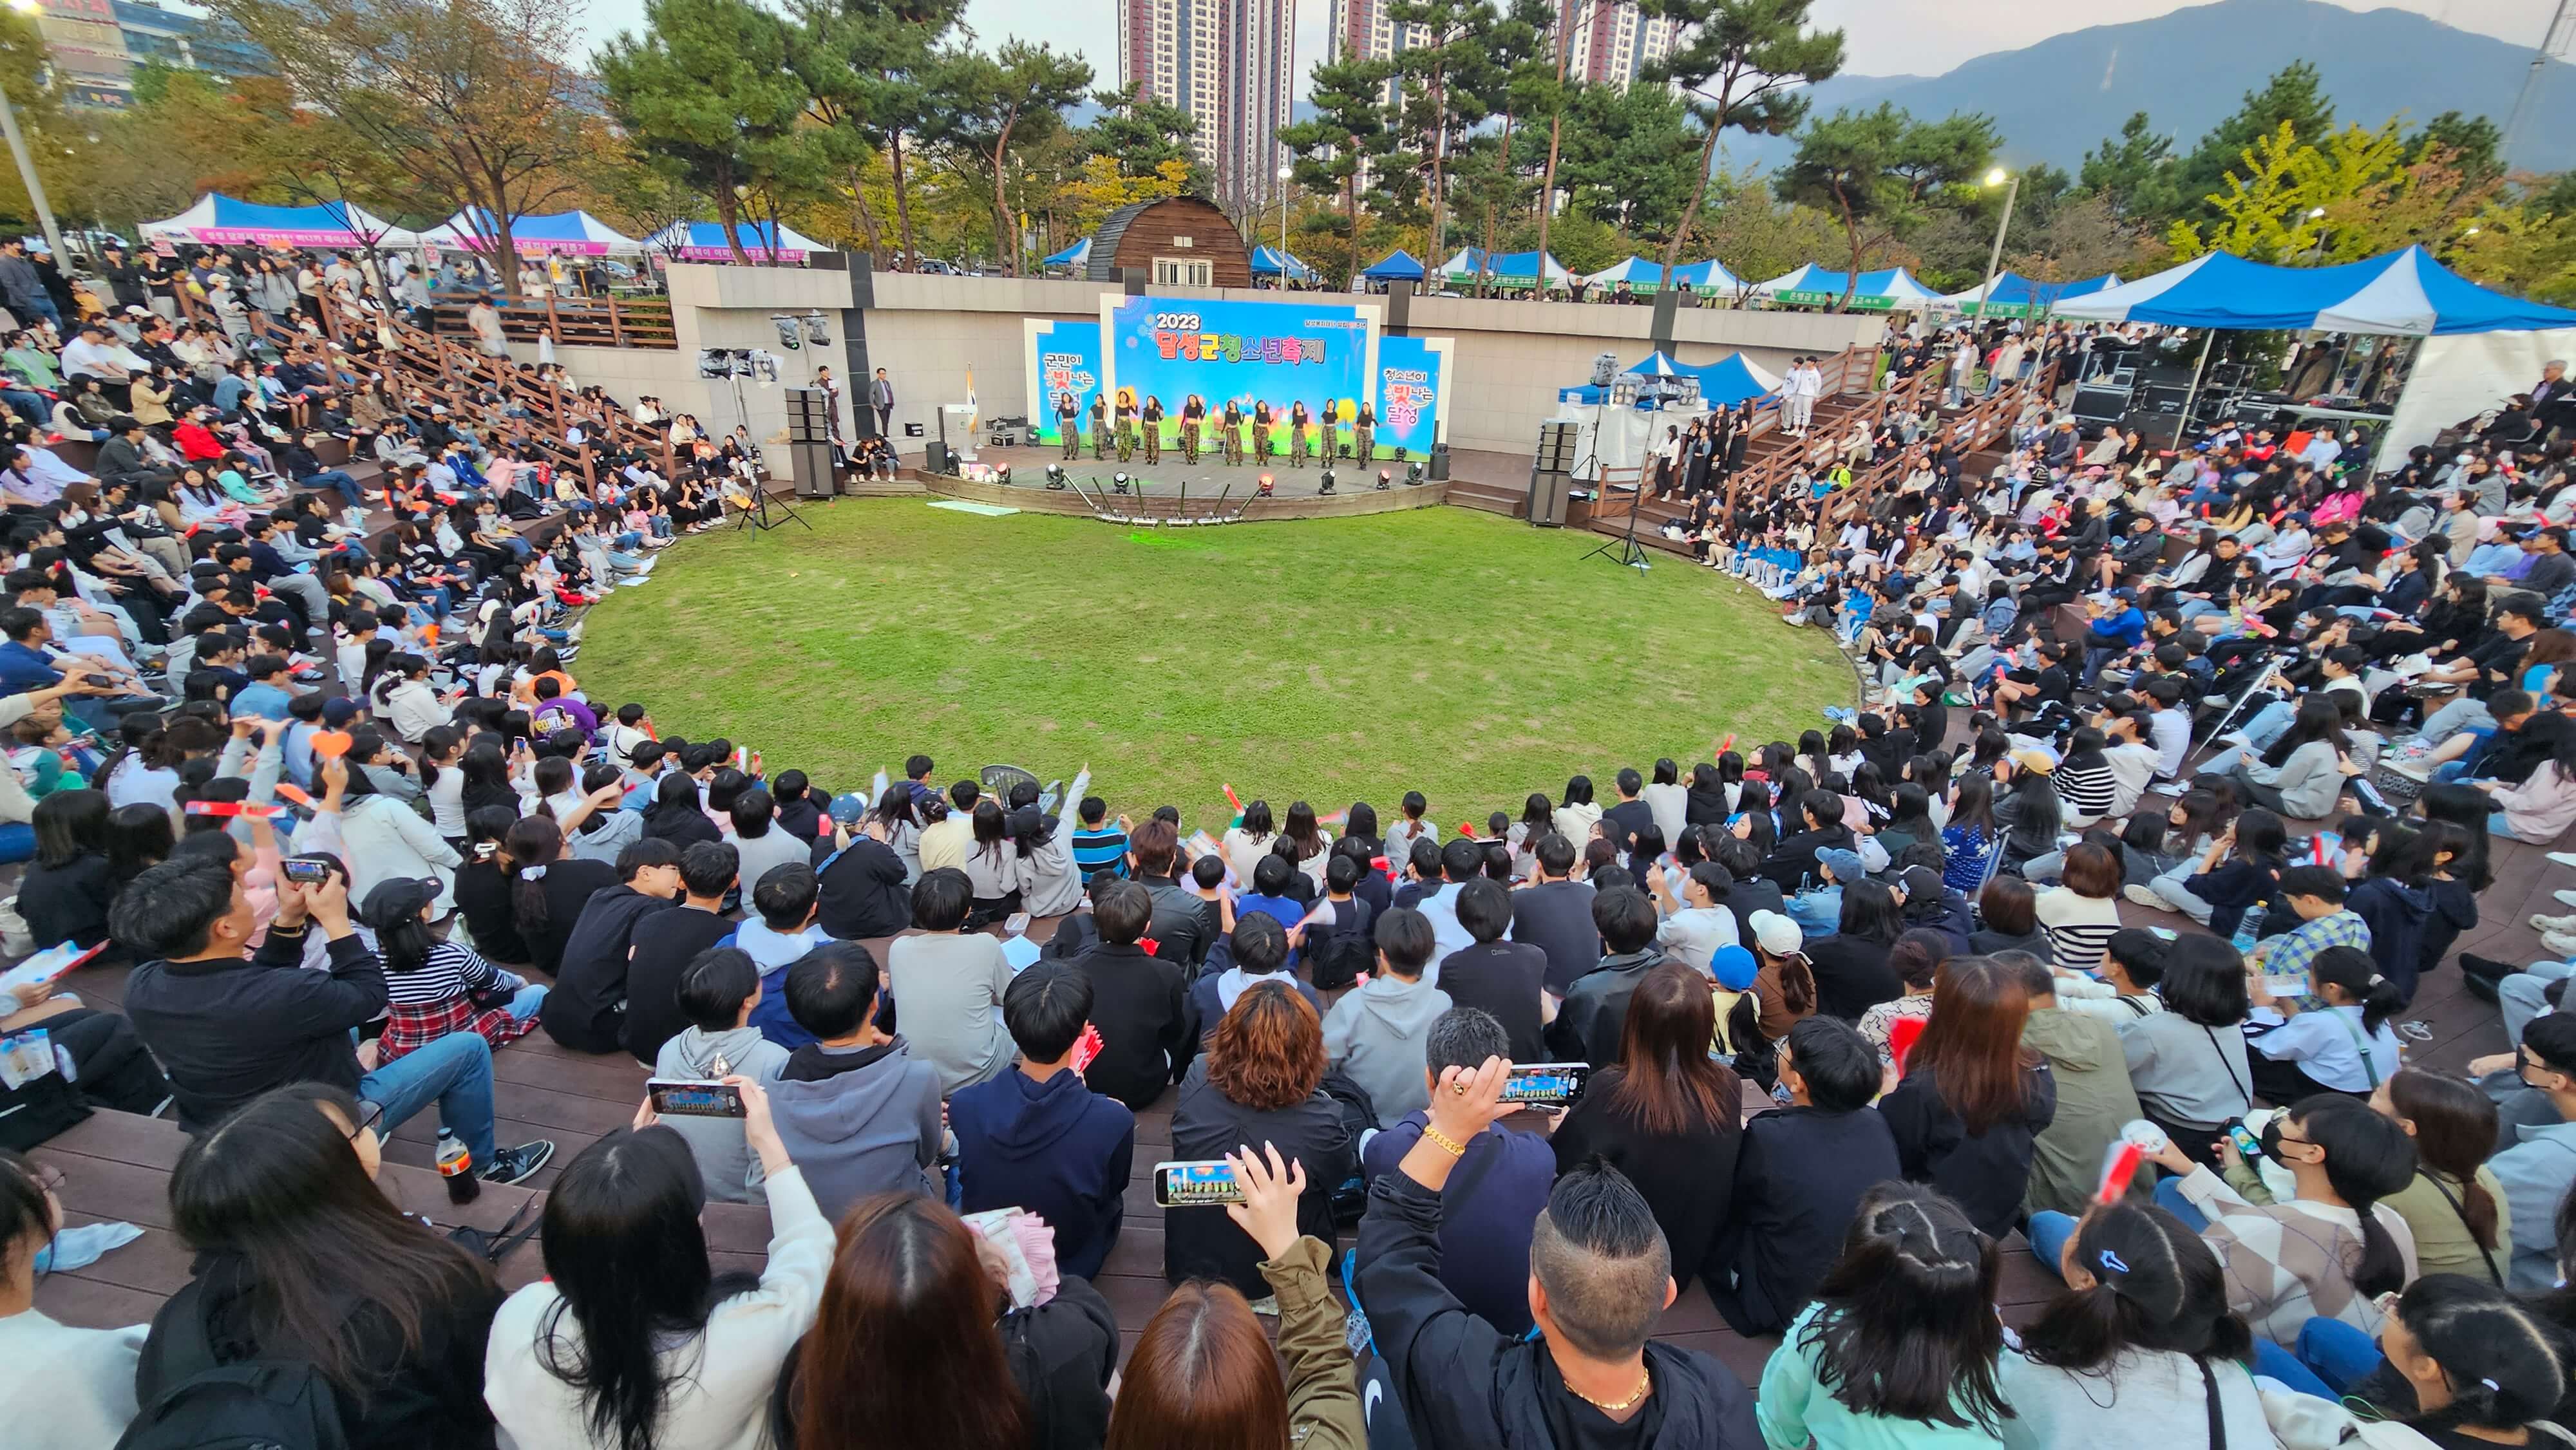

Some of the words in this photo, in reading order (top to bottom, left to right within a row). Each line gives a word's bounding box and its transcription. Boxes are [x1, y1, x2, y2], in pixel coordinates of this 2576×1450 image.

[1156, 313, 1200, 330] 2023
[1156, 332, 1327, 366] 달성군청소년축제
[1044, 354, 1082, 369] 군민이
[1053, 371, 1095, 390] 빛나는
[1385, 369, 1427, 381] 청소년이
[1394, 386, 1434, 405] 빛나는
[1387, 406, 1418, 424] 달성
